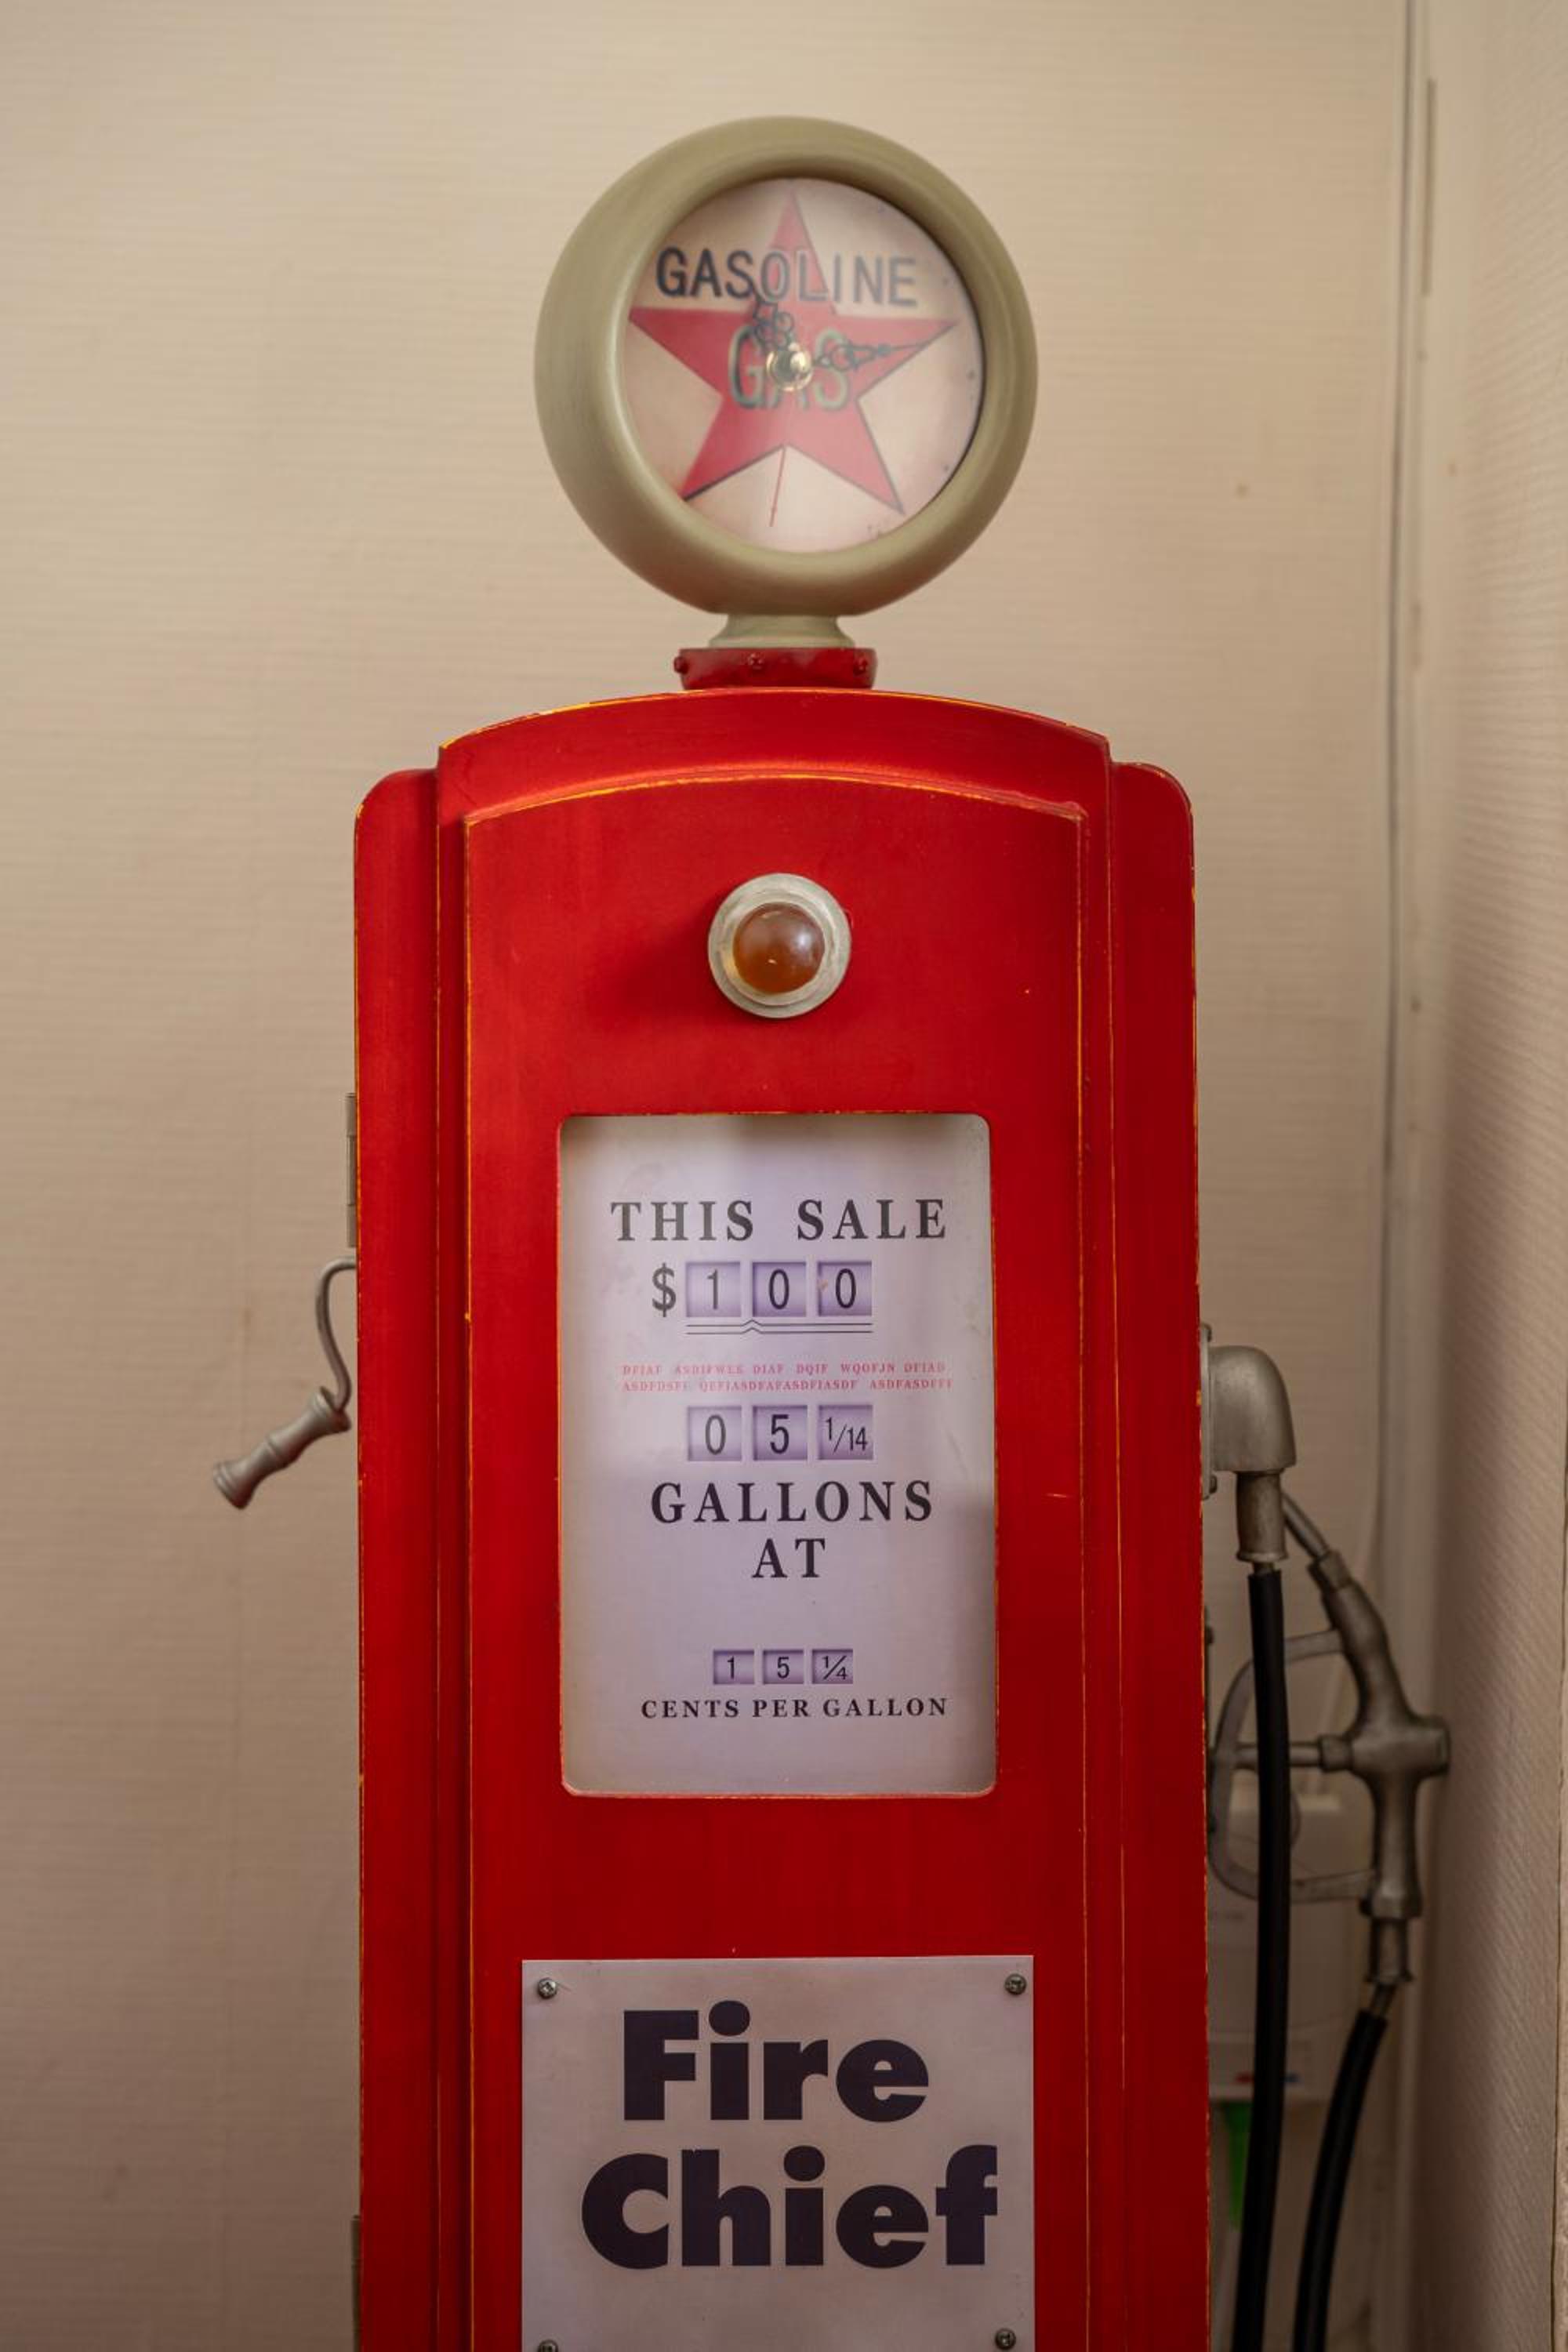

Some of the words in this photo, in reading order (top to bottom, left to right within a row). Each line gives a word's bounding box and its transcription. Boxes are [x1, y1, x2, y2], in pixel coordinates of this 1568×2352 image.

[656, 246, 917, 307] GASOLINE
[611, 1200, 753, 1241] THIS
[797, 1199, 946, 1241] SALE
[652, 1262, 677, 1318] $
[651, 1479, 932, 1524] GALLONS
[752, 1537, 826, 1578] AT
[641, 1699, 739, 1719] CENTS
[752, 1699, 808, 1718] PER
[822, 1697, 946, 1716] GALLON
[623, 2000, 929, 2123] Fire
[581, 2144, 998, 2270] Chief
